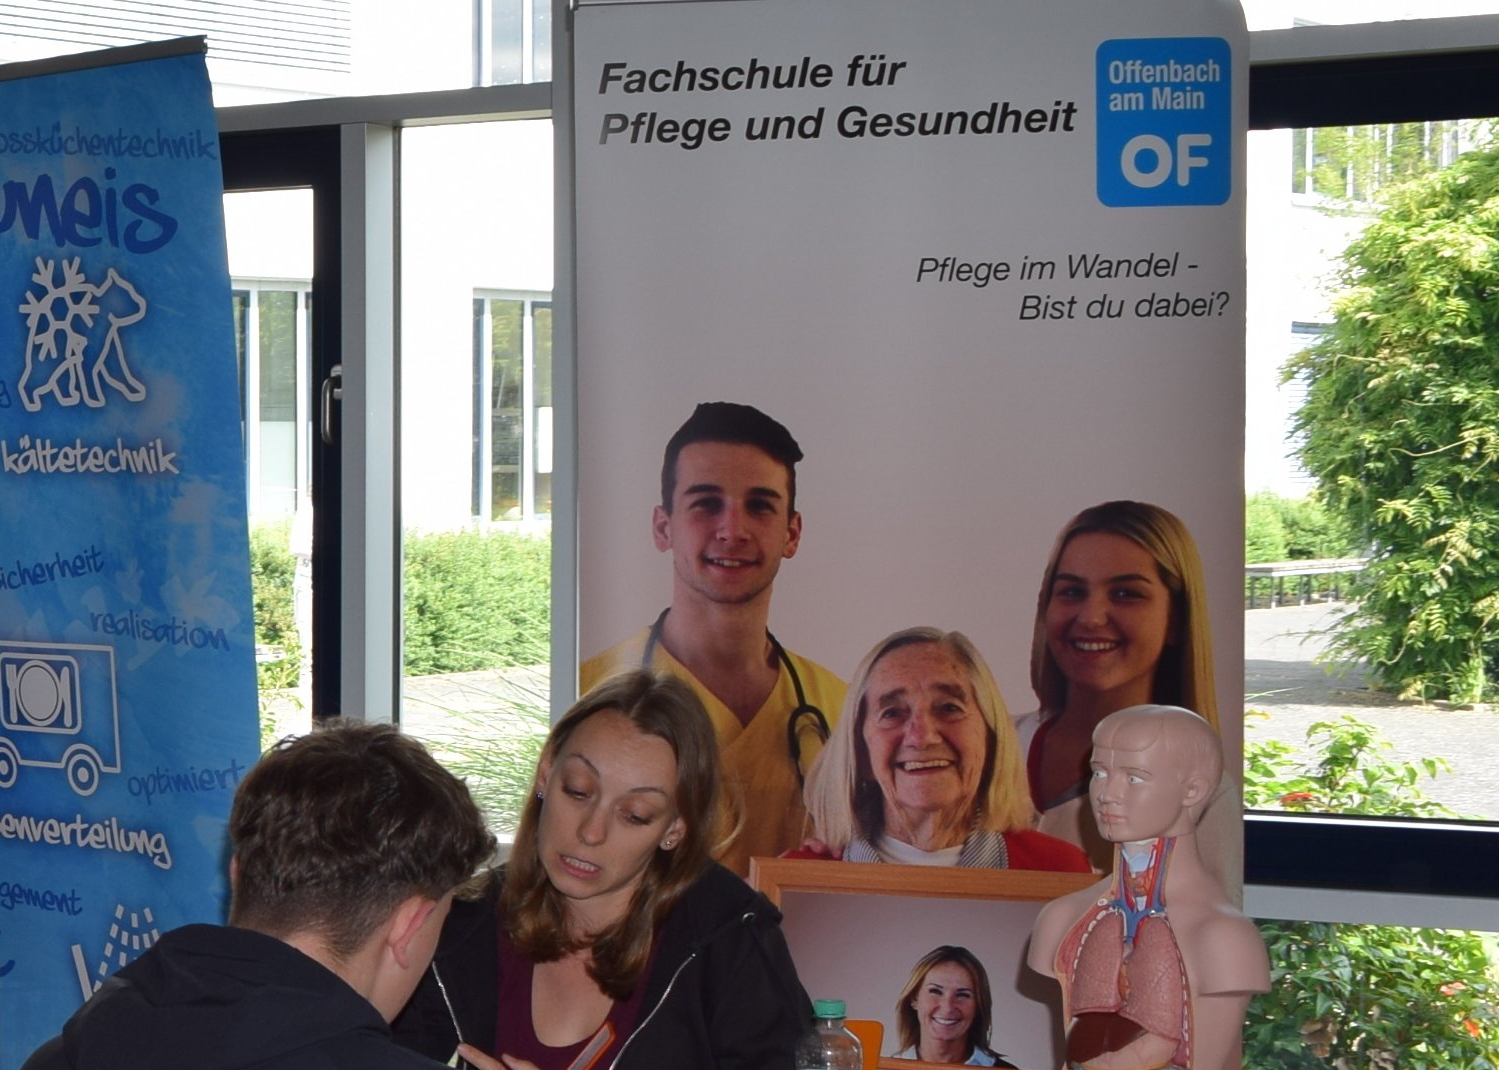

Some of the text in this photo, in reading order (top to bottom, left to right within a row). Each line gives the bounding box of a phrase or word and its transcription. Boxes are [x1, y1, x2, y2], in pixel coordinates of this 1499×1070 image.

[598, 54, 906, 96] Fachschule für
[1108, 59, 1221, 84] Offenbach
[1108, 87, 1205, 111] am Main
[598, 100, 1078, 151] Pflege und Gesundheit
[1120, 134, 1212, 188] OF
[916, 255, 1010, 287] Pflege
[1019, 254, 1054, 280] im
[1066, 252, 1178, 279] Wandel
[1018, 291, 1231, 321] Bist du dabei?
[0, 435, 179, 474] kältetechnik
[89, 609, 231, 652] realisation
[126, 758, 246, 805] optimiert
